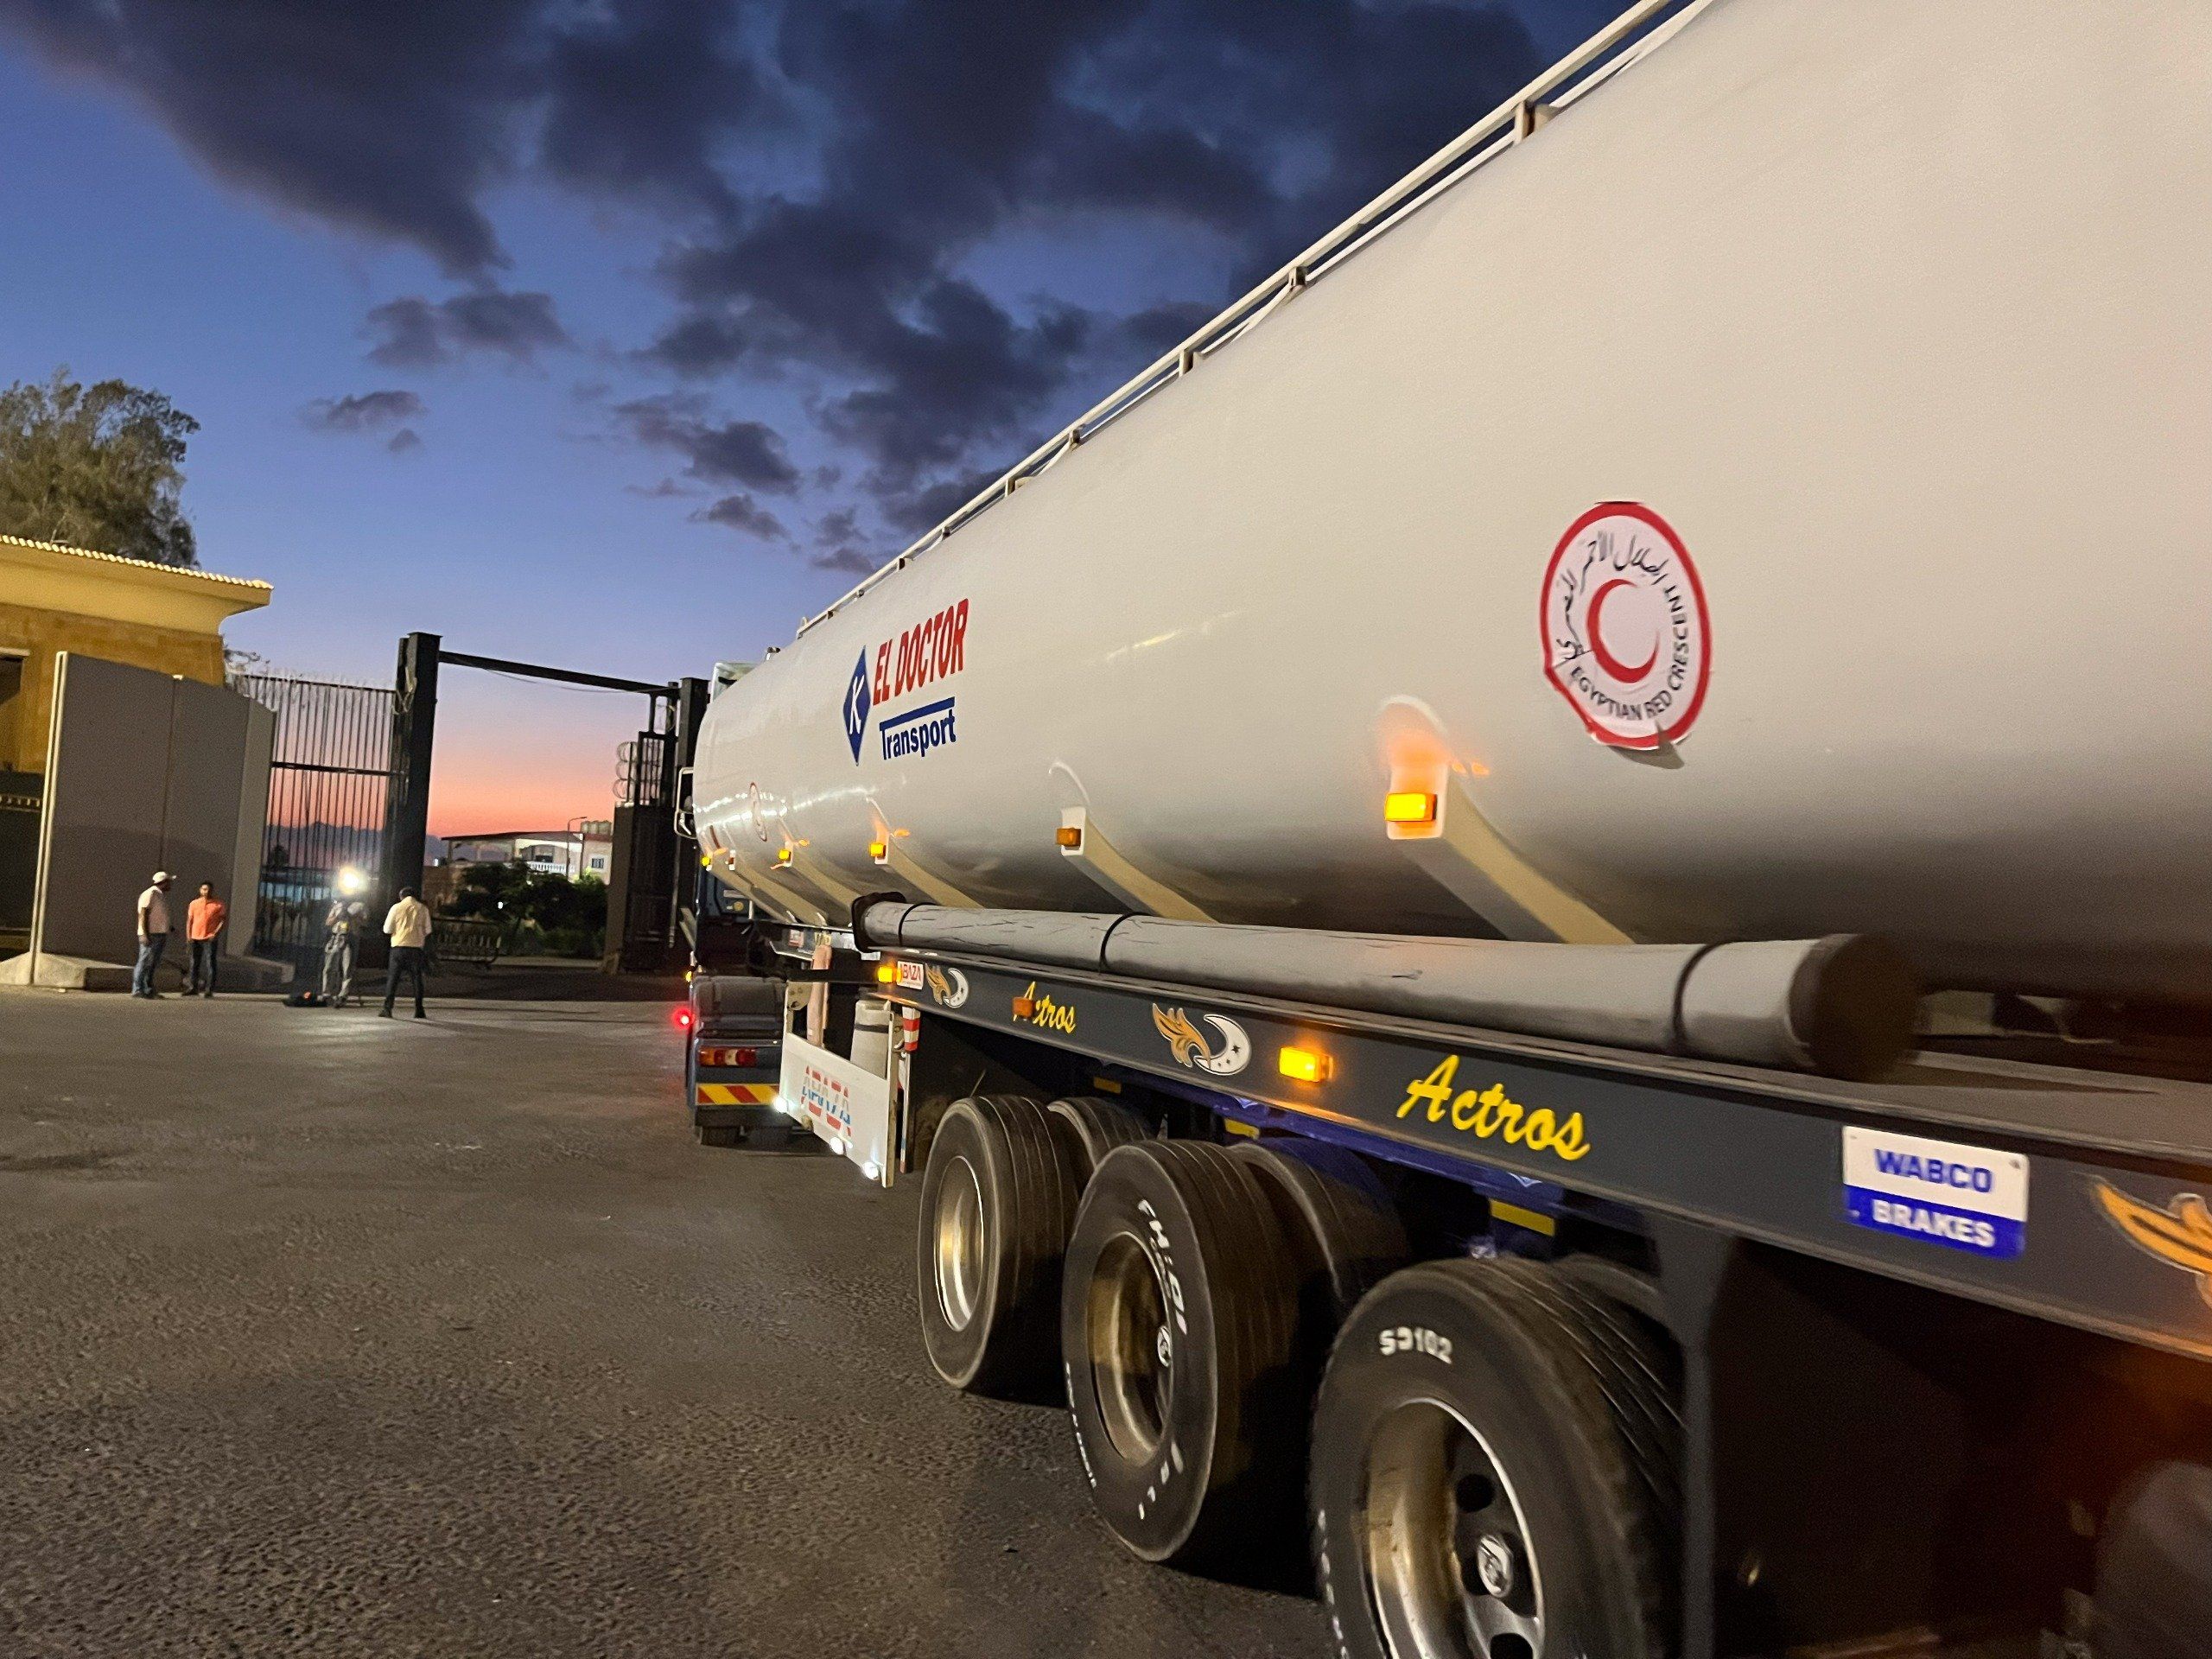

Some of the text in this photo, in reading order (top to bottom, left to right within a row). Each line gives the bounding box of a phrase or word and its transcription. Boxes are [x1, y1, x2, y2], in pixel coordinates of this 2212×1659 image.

[873, 598, 969, 706] EL DOCTOR
[1568, 584, 1690, 721] EGYPTIAN RED CRESCENT
[849, 673, 864, 734] K
[879, 696, 957, 760] Transport
[1396, 1055, 1591, 1160] Actros
[1873, 1148, 1993, 1194] WABCO
[1872, 1198, 1995, 1249] BRAKES
